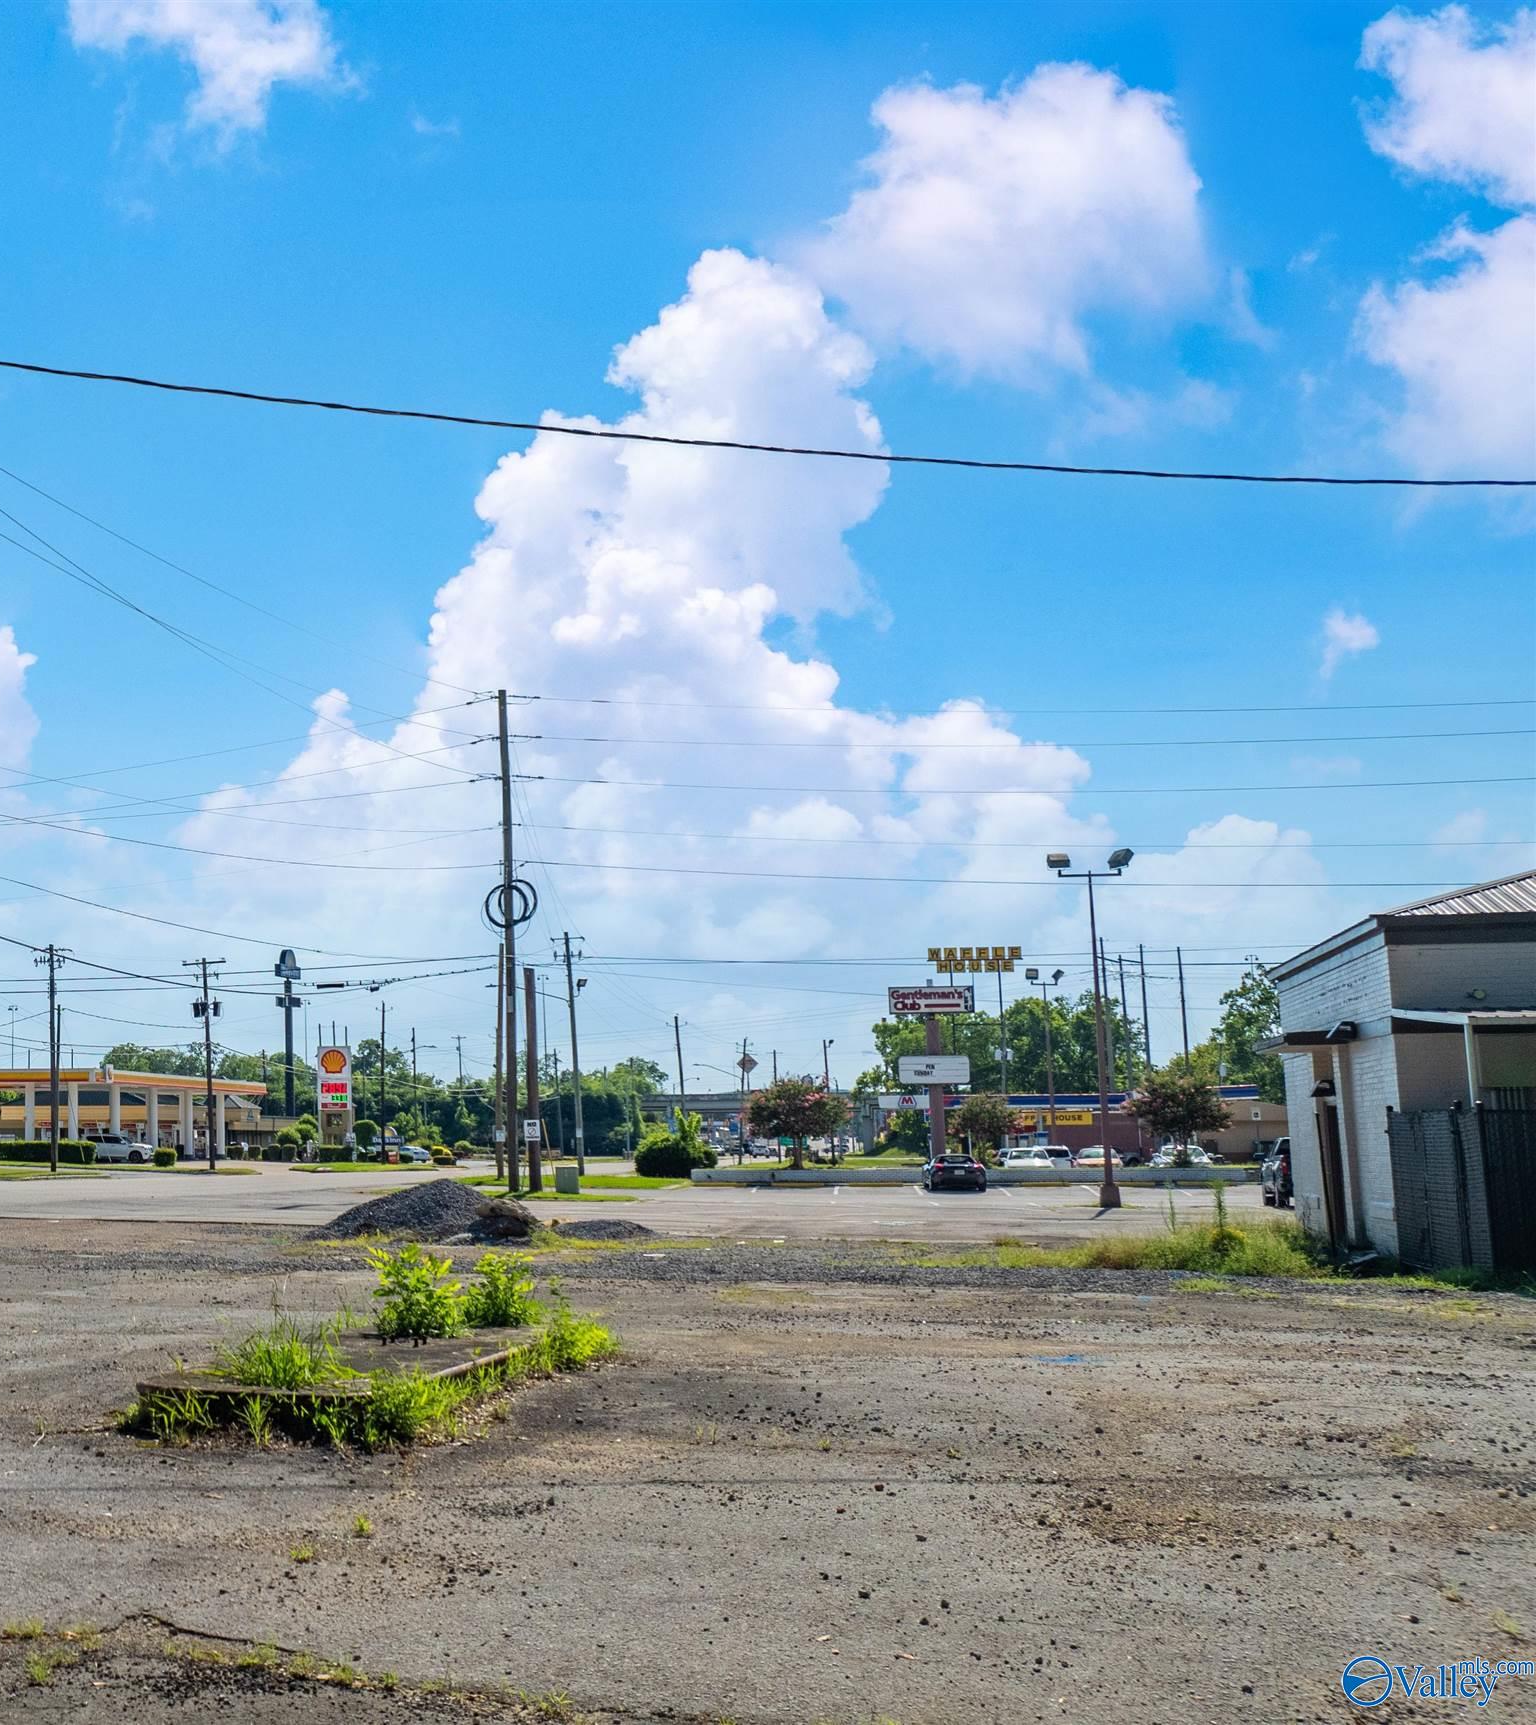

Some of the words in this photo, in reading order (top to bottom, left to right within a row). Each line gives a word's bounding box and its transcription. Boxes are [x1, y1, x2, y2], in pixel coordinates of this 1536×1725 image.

[929, 947, 1020, 959] WAFFLE
[939, 961, 1013, 971] HOUSE
[890, 989, 964, 1001] Gentleman's
[893, 1001, 922, 1011] Club
